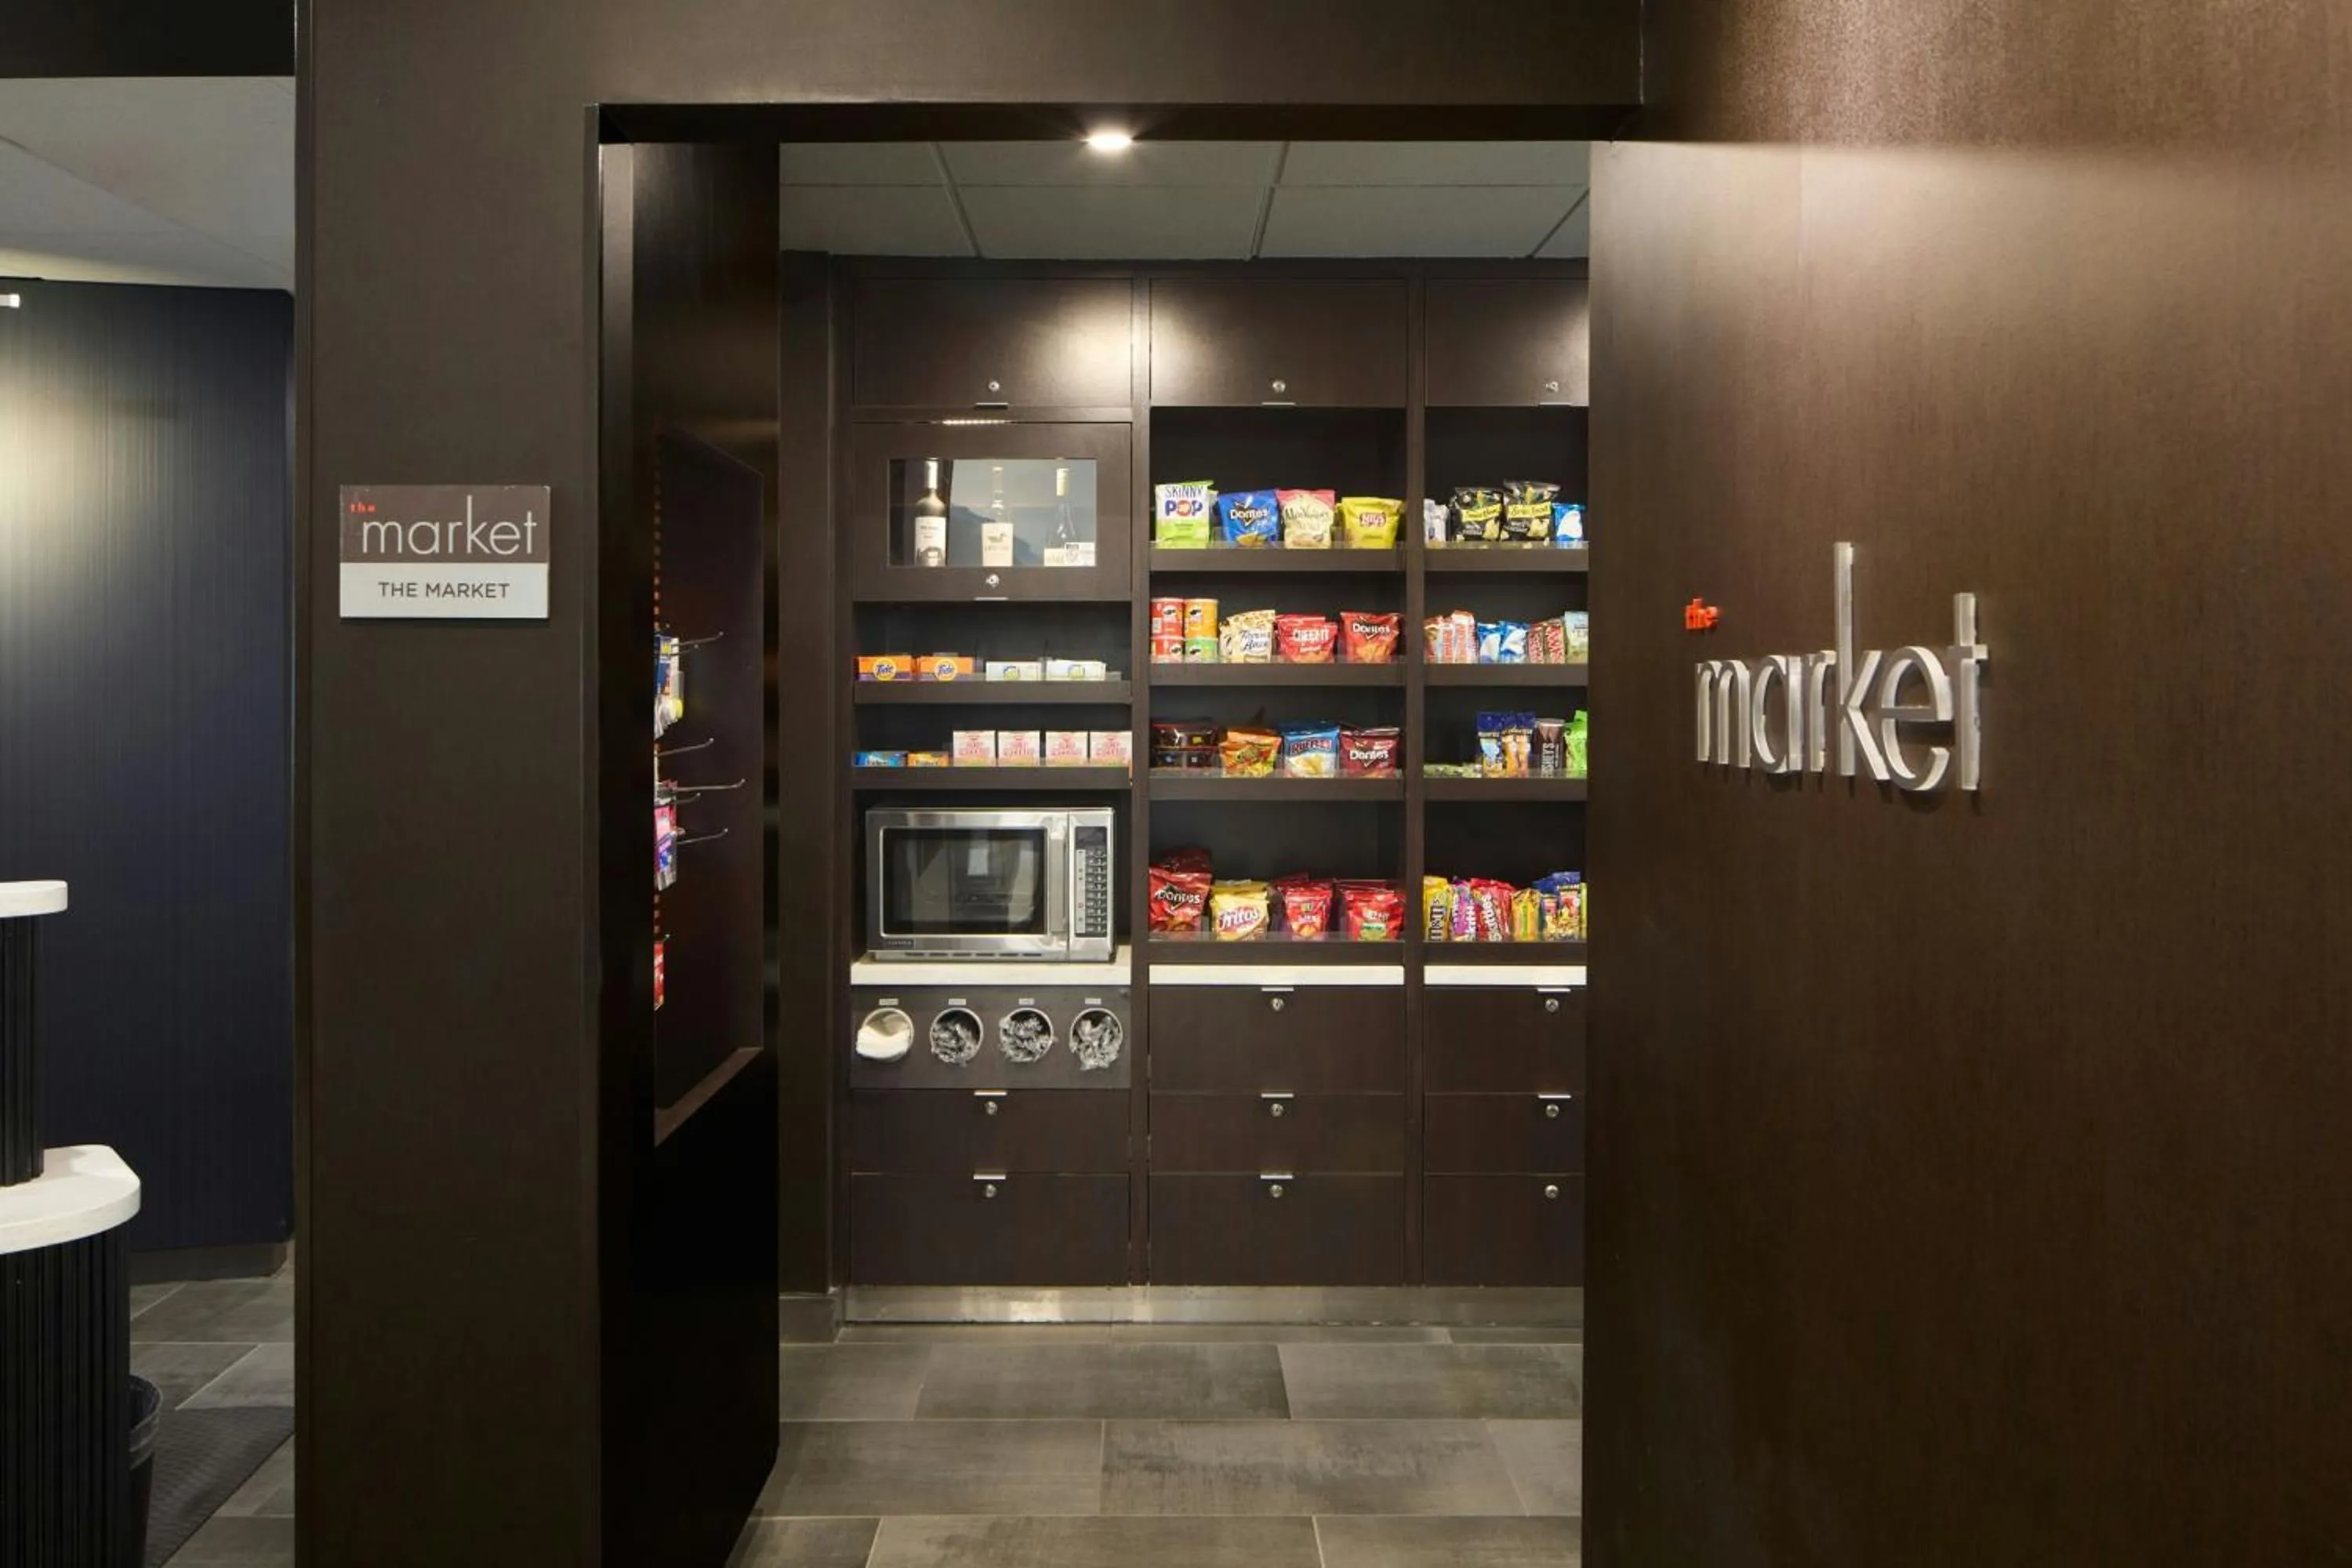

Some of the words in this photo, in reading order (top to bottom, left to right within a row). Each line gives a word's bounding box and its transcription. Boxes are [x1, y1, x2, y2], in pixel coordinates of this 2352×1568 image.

[1164, 485, 1203, 499] SKINNY
[350, 501, 376, 514] the
[1164, 500, 1203, 517] POP
[362, 495, 538, 555] market
[378, 582, 417, 597] THE
[425, 583, 510, 598] MARKET
[1685, 597, 1720, 630] the
[1695, 542, 1988, 791] market
[1350, 750, 1389, 760] Doritos
[1154, 890, 1202, 904] Doritos
